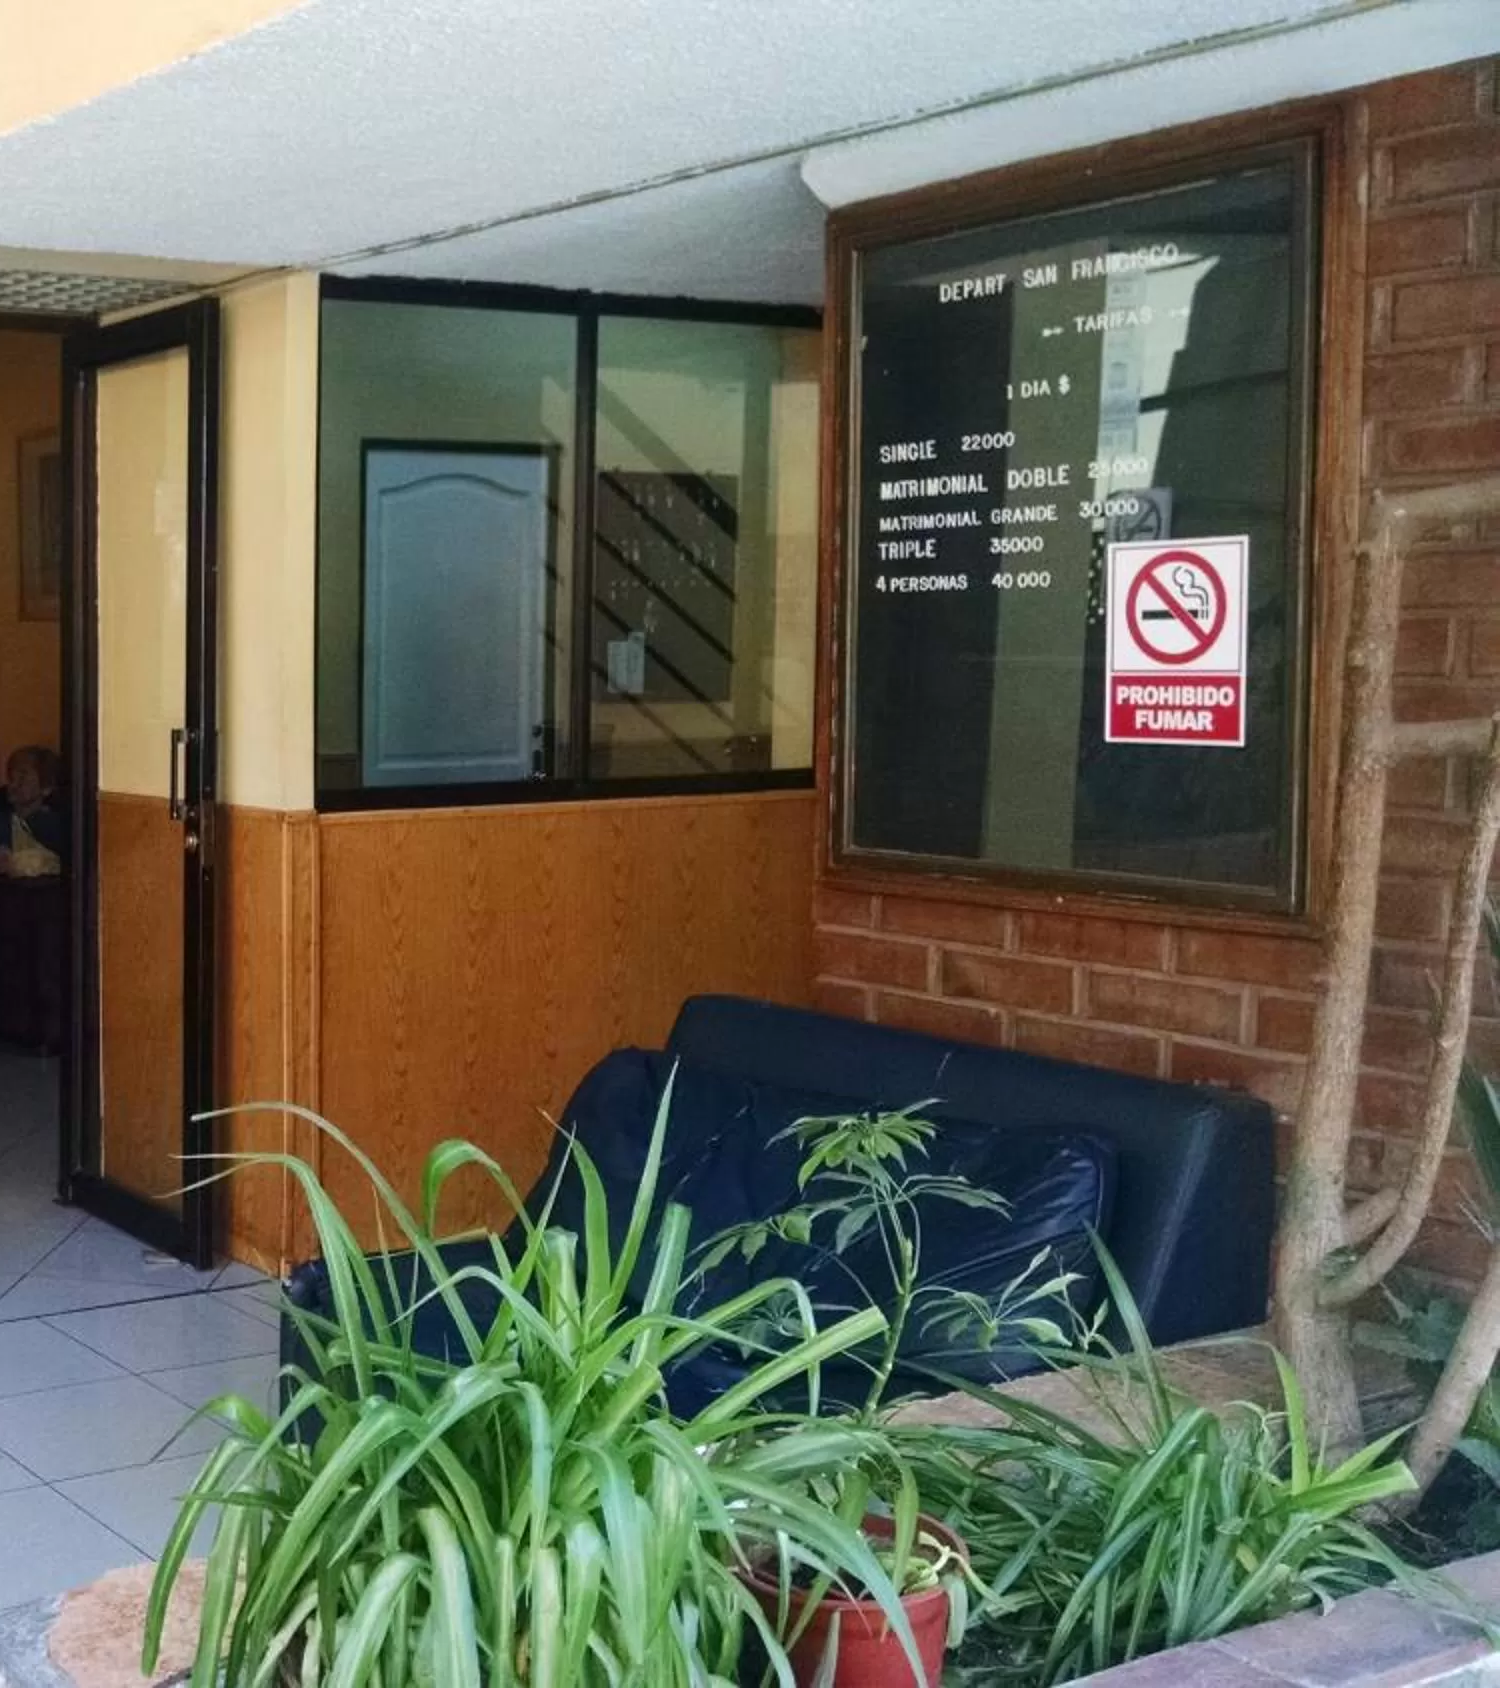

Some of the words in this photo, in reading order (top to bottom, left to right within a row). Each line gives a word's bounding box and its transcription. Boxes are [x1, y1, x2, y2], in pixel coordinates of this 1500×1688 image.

[939, 273, 1007, 302] DEPART
[1022, 264, 1058, 289] SAN
[1071, 242, 1180, 281] FRANCISCO
[1074, 305, 1153, 333] TARIFAS
[1021, 380, 1051, 399] DIA
[1058, 374, 1071, 395] $
[879, 440, 937, 464] SINGLE
[961, 431, 1016, 451] 22000
[879, 474, 988, 500] MATRIMONIAL
[1007, 464, 1070, 491] DOBLE
[879, 511, 982, 532] MATRIMONIAL
[991, 505, 1059, 525] GRANDE
[878, 539, 937, 561] TRIPLE
[990, 536, 1043, 555] 35000
[875, 575, 886, 592] 4
[890, 573, 968, 593] PERSONAS
[1116, 685, 1235, 707] PROHIBIDO
[1135, 709, 1213, 731] FUMAR
